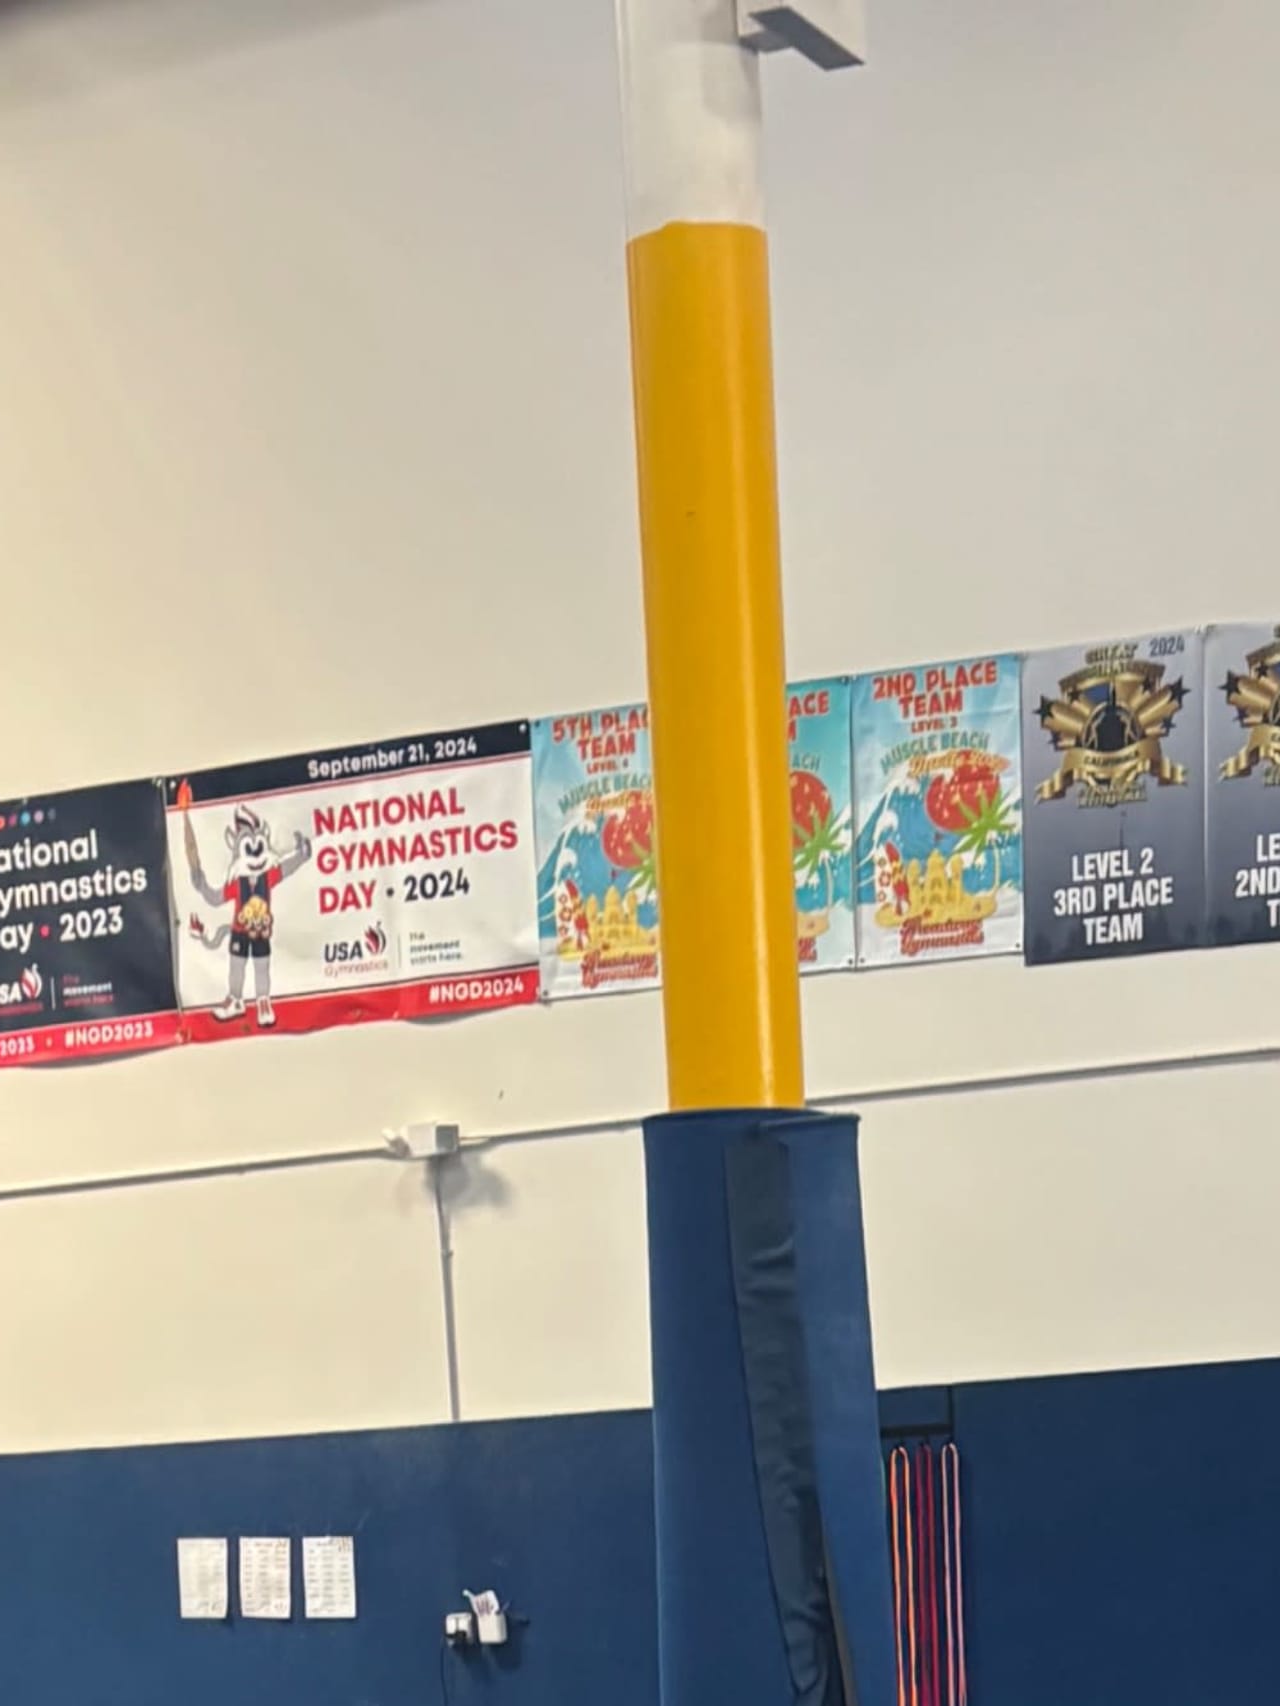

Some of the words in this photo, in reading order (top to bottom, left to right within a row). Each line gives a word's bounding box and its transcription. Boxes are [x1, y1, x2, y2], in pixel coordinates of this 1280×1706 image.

[1149, 634, 1185, 657] 2024
[873, 674, 916, 700] 2ND
[926, 661, 997, 691] PLACE
[789, 691, 829, 718] ACE
[899, 690, 963, 719] TEAM
[552, 715, 593, 743] 5TH
[601, 707, 649, 734] PLAC
[308, 748, 403, 780] September
[408, 742, 430, 762] 21,
[435, 737, 477, 759] 2024
[577, 733, 636, 762] TEAM
[880, 733, 937, 776] MUSCLE
[941, 730, 990, 751] BEACH
[613, 773, 652, 791] BEAC
[313, 788, 465, 836] NATIONAL
[317, 821, 518, 875] GYMNASTICS
[1072, 850, 1133, 883] LEVEL
[1139, 847, 1154, 874] 2
[319, 880, 376, 914] DAY
[404, 868, 470, 902] 2024
[1054, 886, 1097, 916] 3RD
[1103, 877, 1174, 911] PLACE
[60, 906, 123, 942] 2023
[1083, 913, 1143, 945] TEAM
[324, 940, 363, 963] USA
[429, 976, 524, 1005] #NGD2024
[0, 1036, 35, 1057] 2023
